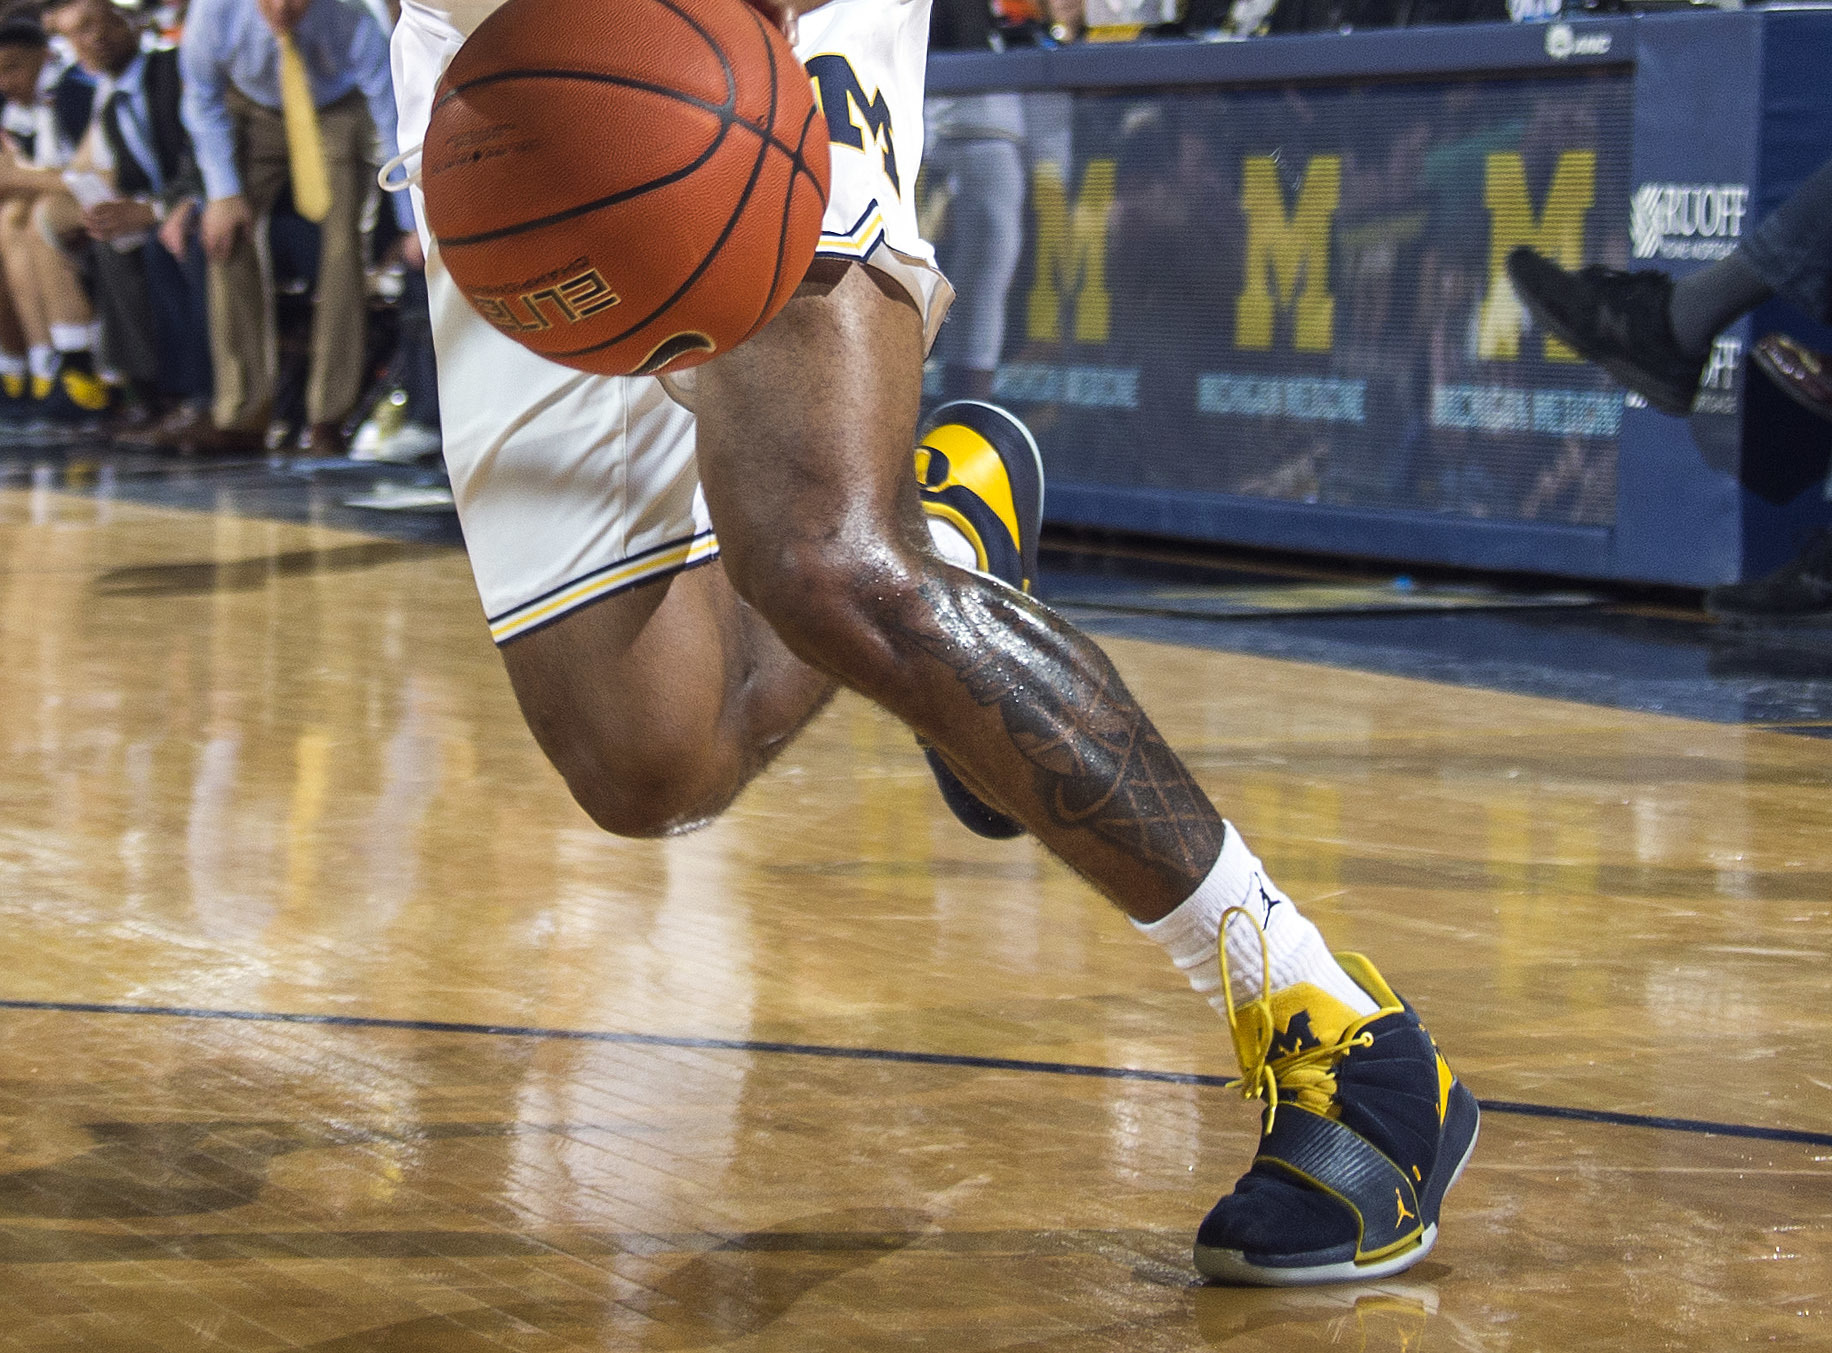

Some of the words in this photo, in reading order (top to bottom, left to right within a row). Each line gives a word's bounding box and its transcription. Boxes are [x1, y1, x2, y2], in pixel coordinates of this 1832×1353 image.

[1026, 157, 1117, 344] M
[1233, 154, 1342, 354] M
[1477, 150, 1597, 363] M
[1662, 185, 1750, 238] RUOFF
